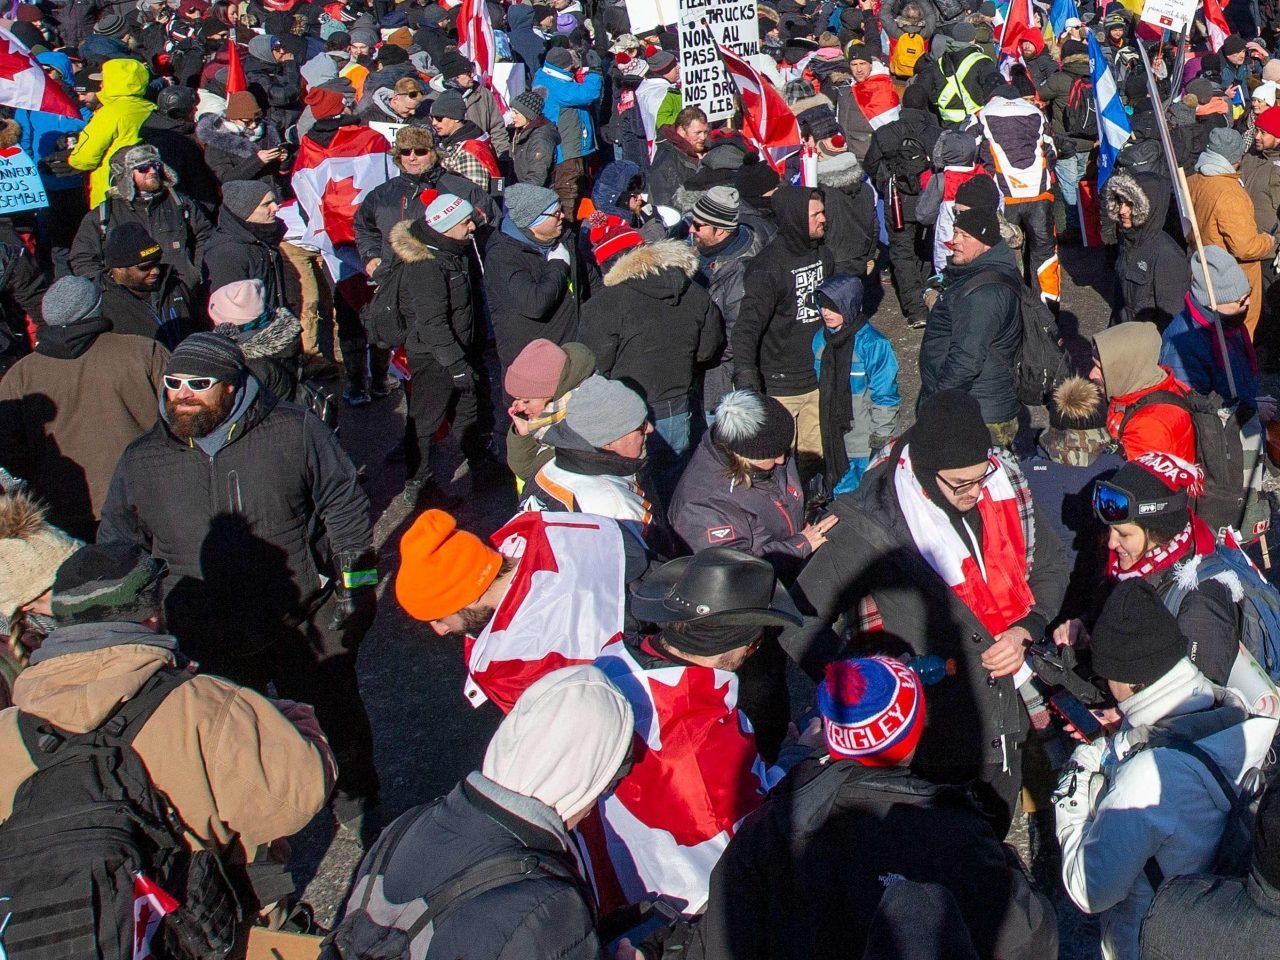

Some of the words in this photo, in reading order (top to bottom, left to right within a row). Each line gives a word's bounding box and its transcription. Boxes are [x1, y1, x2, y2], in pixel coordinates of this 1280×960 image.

[705, 4, 755, 24] TRUCKS
[722, 25, 739, 43] AU
[685, 66, 720, 85] UNIS
[684, 85, 708, 102] NOS
